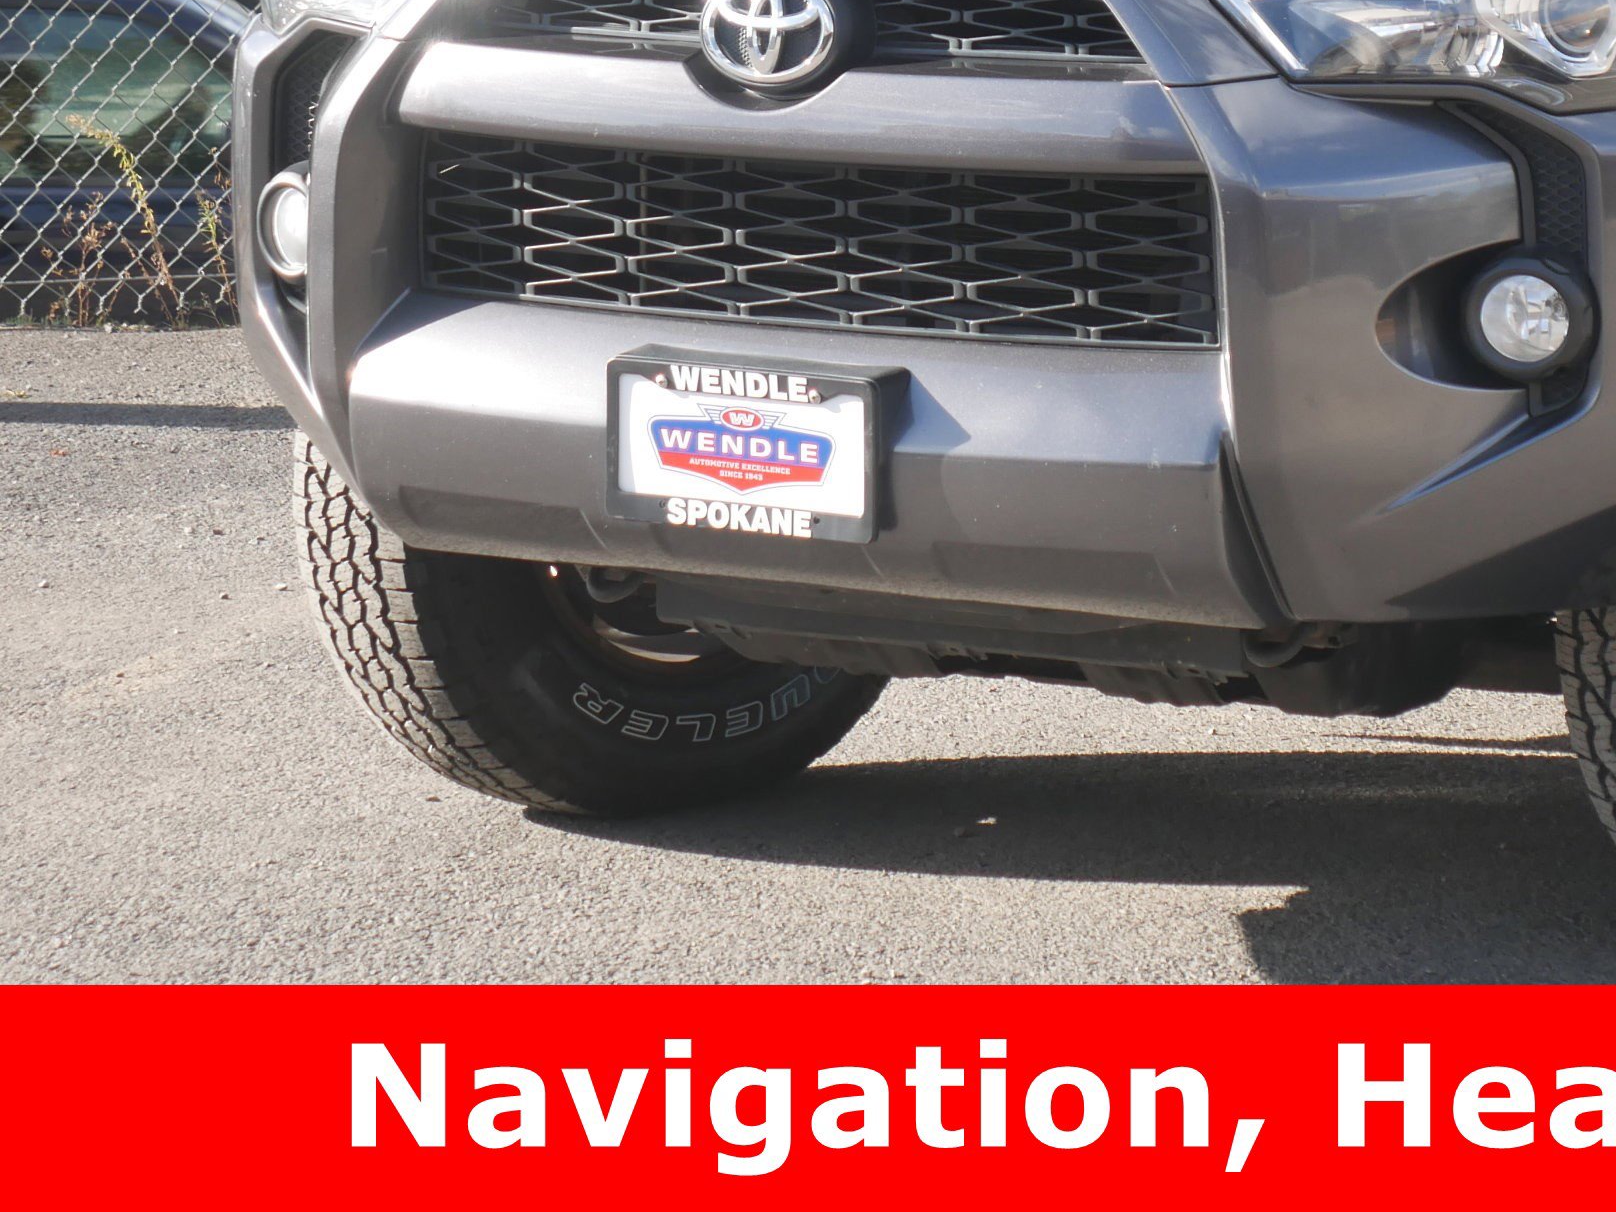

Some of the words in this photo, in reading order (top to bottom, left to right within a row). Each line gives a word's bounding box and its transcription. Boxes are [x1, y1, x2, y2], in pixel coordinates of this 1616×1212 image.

[670, 364, 810, 404] WENDLE
[659, 428, 819, 464] WENDLE
[688, 457, 740, 470] AUTOMOTIVE
[741, 462, 791, 475] EXCELLENCE
[719, 470, 743, 480] SINCE
[666, 498, 813, 538] SPOKANE
